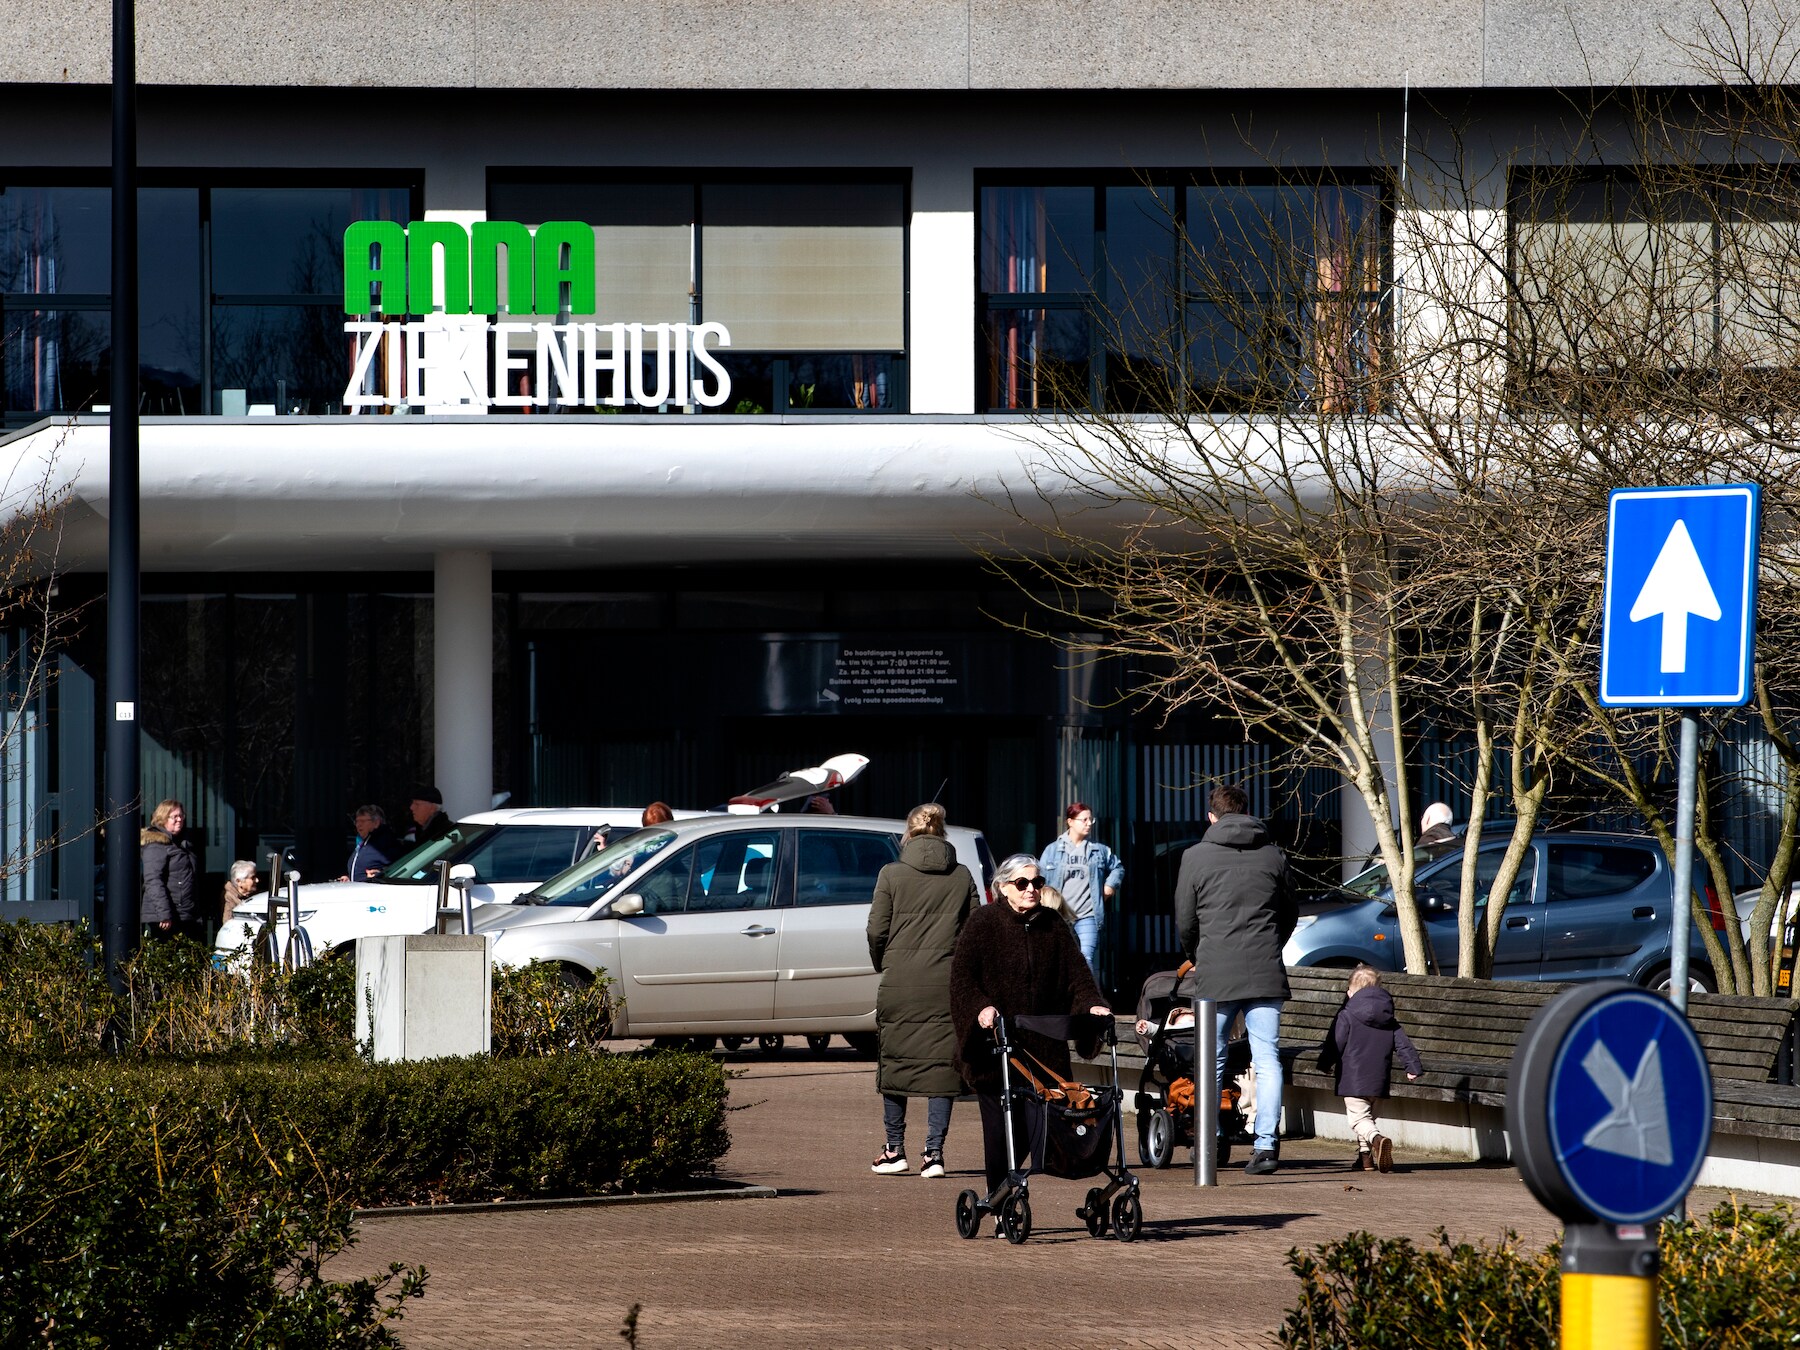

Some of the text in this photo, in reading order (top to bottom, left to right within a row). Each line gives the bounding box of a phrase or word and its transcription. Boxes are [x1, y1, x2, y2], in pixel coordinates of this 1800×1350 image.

[343, 220, 597, 315] ANNA
[343, 321, 732, 408] ZIEKENHUIS
[854, 649, 896, 658] hoofdingang
[905, 649, 933, 658] geopend
[934, 650, 943, 658] op
[889, 658, 907, 668] 7:00
[870, 678, 889, 686] tijden
[890, 679, 909, 687] graag
[911, 678, 935, 687] gebruik
[875, 687, 885, 695] de
[885, 687, 926, 696] nachtingang
[844, 697, 861, 705] (volg
